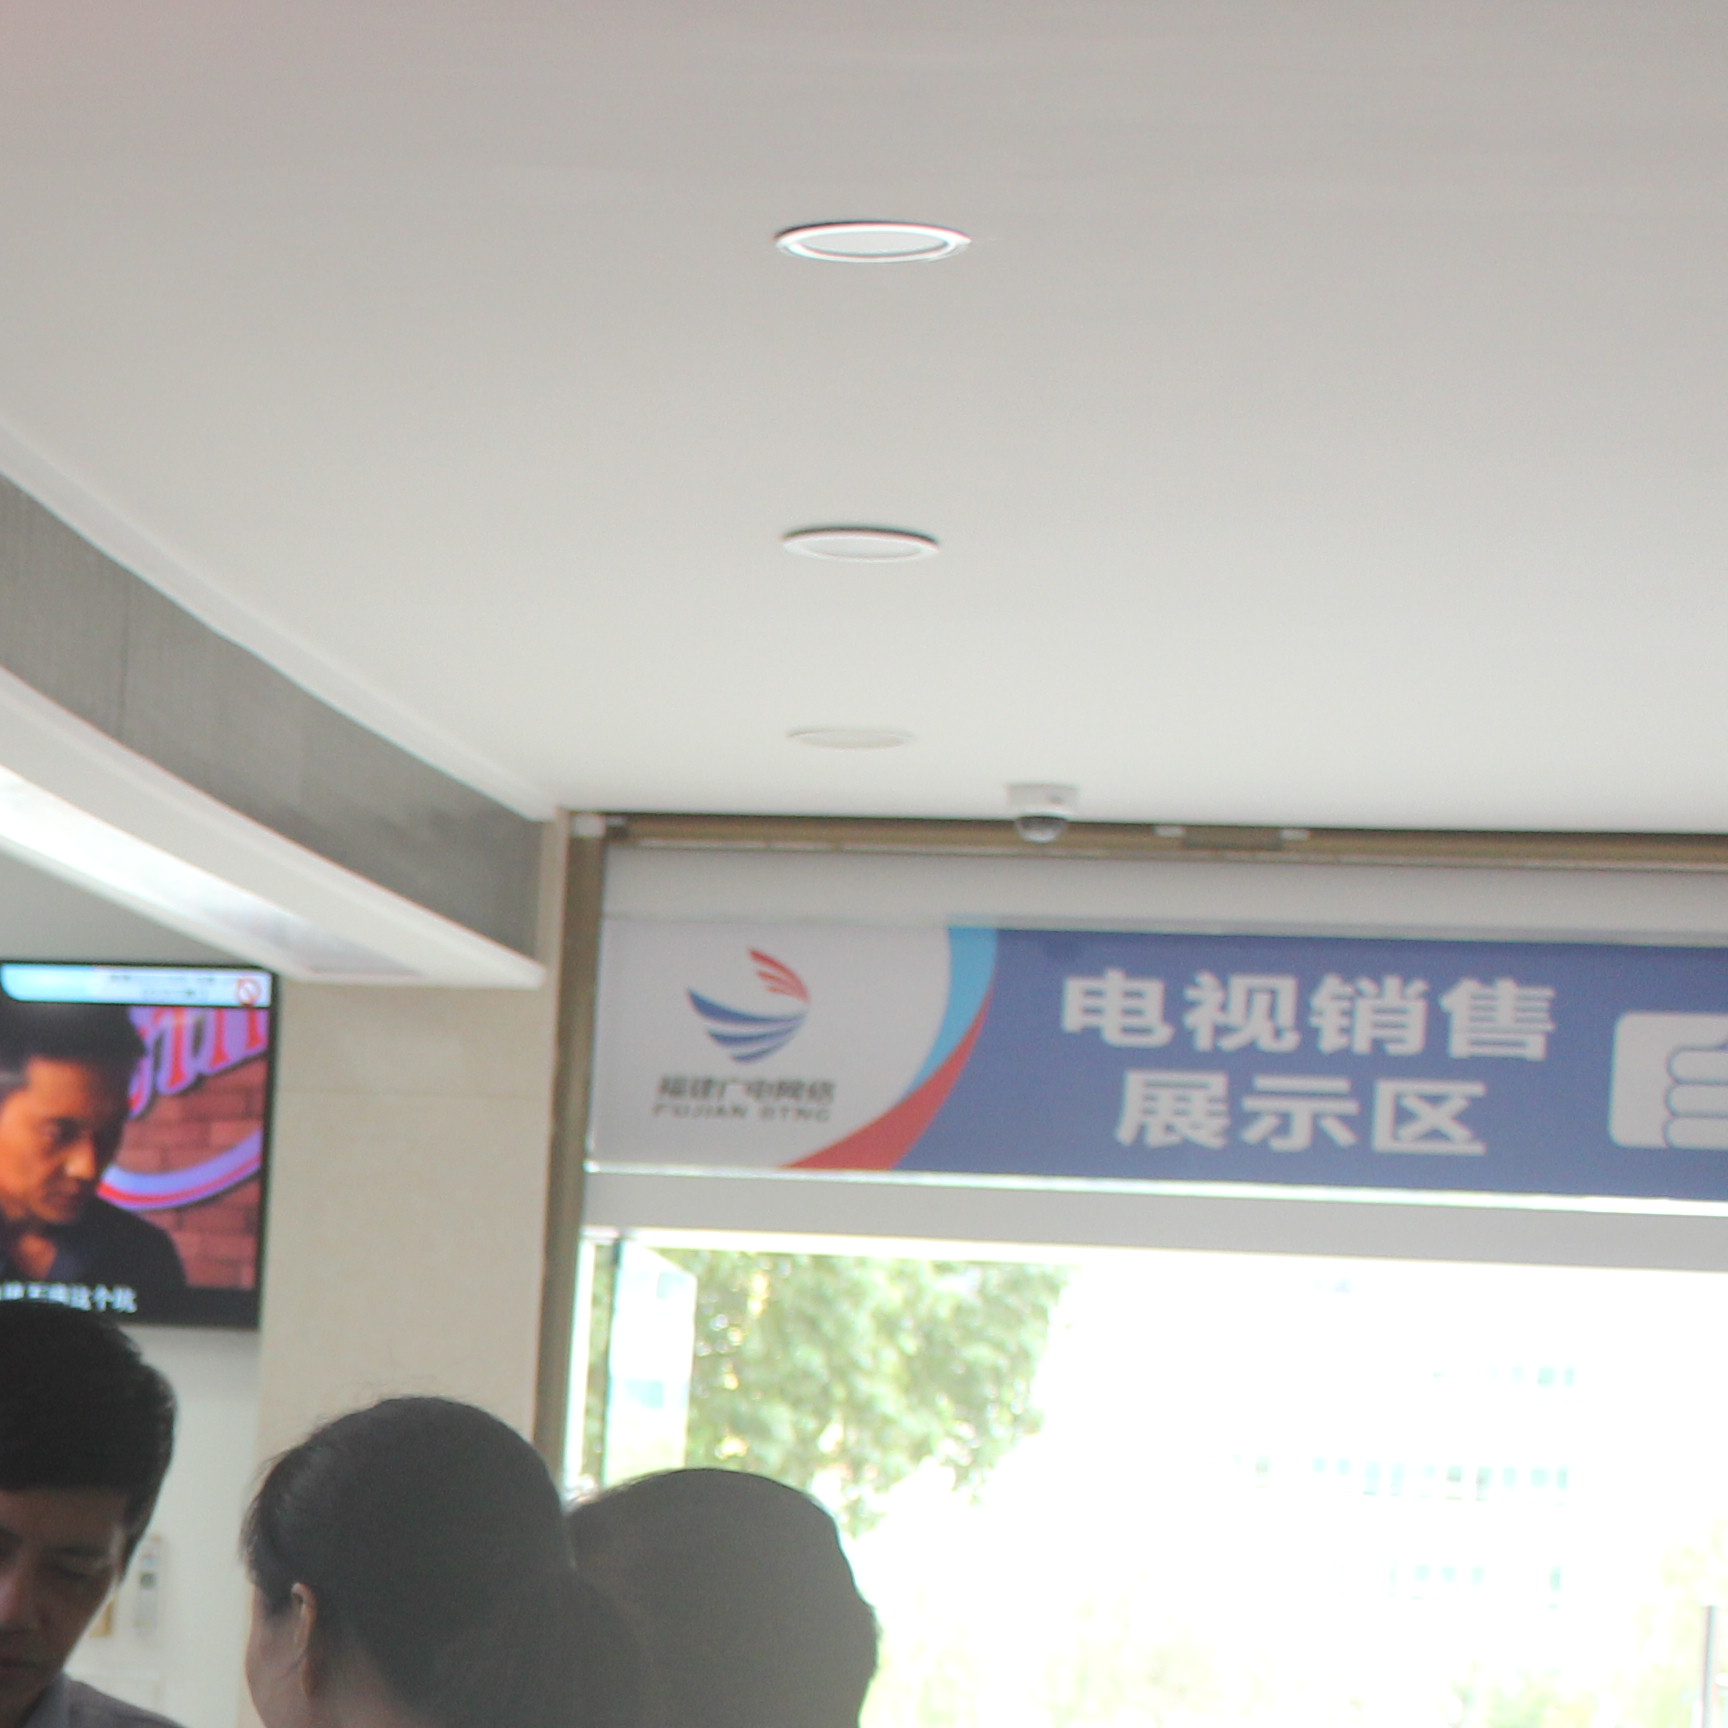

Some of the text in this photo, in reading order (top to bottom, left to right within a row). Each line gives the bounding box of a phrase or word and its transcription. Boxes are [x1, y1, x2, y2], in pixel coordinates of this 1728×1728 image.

[1058, 967, 1557, 1062] 电视销售
[1114, 1068, 1488, 1157] 展示区
